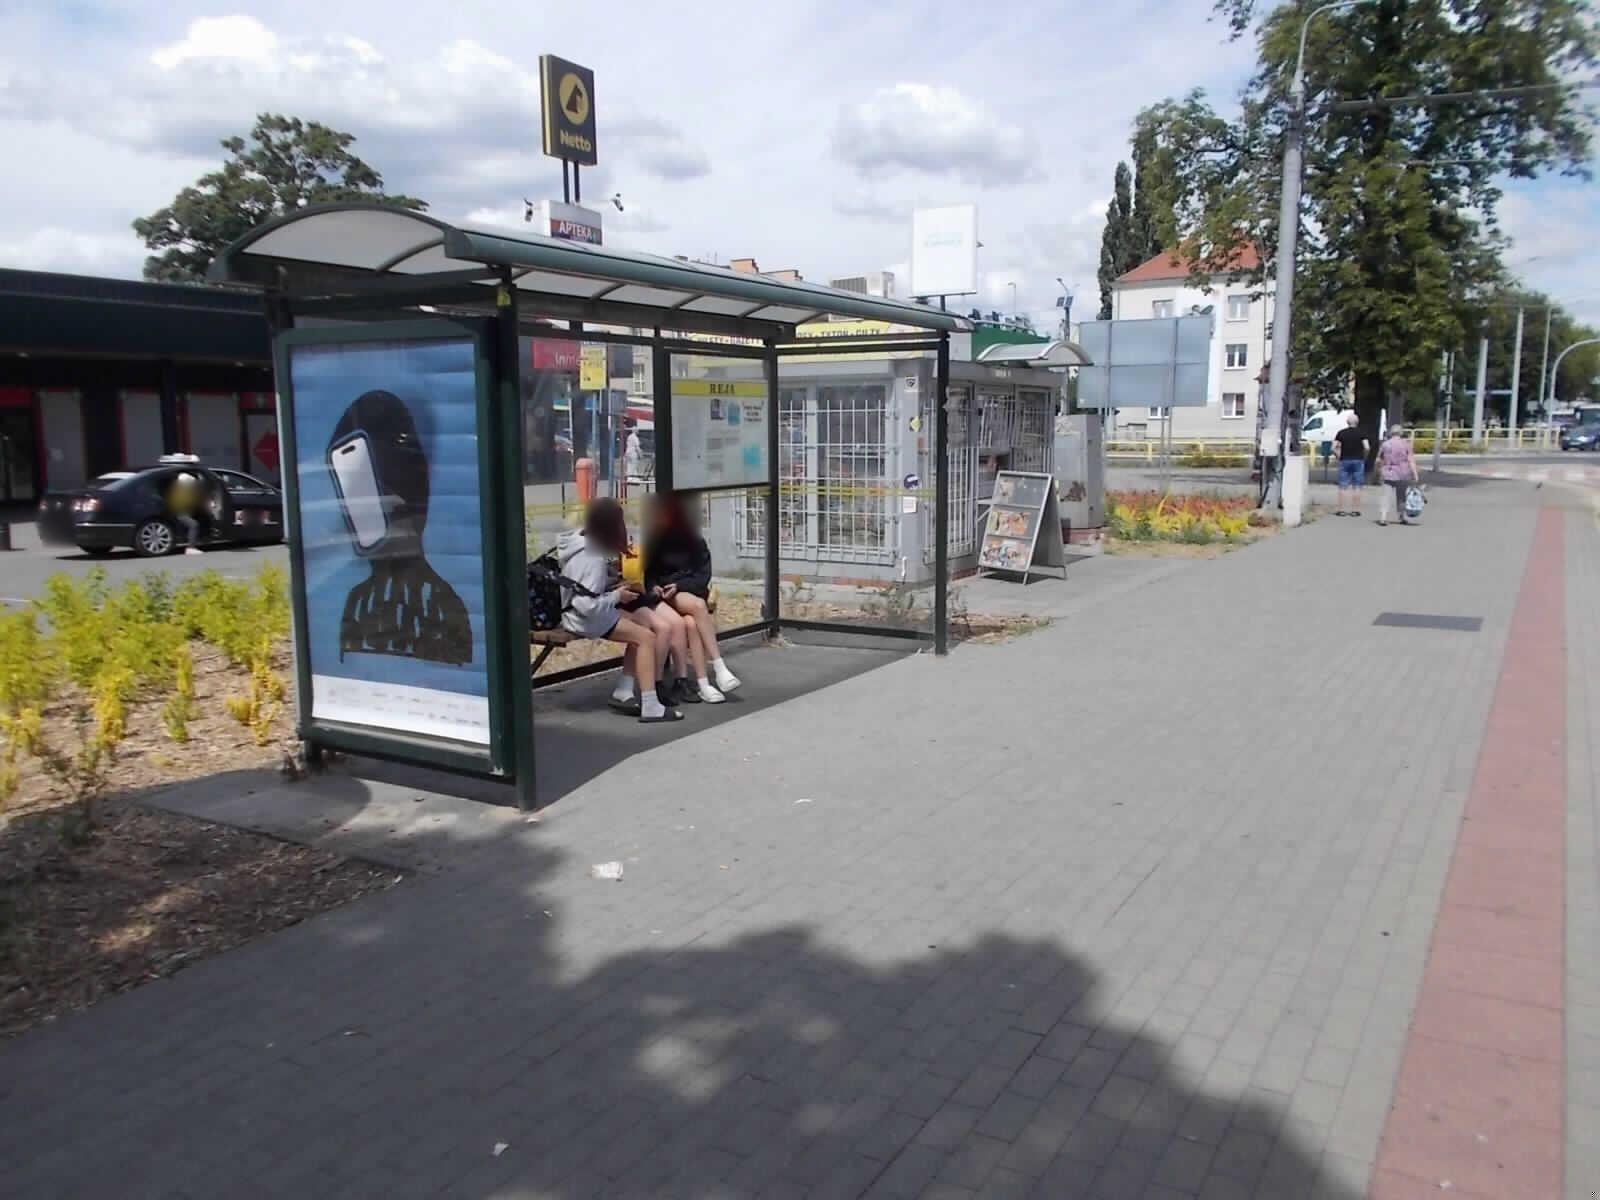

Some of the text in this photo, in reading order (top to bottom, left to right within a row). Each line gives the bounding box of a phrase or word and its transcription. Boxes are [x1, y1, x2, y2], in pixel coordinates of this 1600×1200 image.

[559, 128, 591, 152] Netto
[559, 221, 593, 240] APTEKA
[709, 382, 735, 394] REJA
